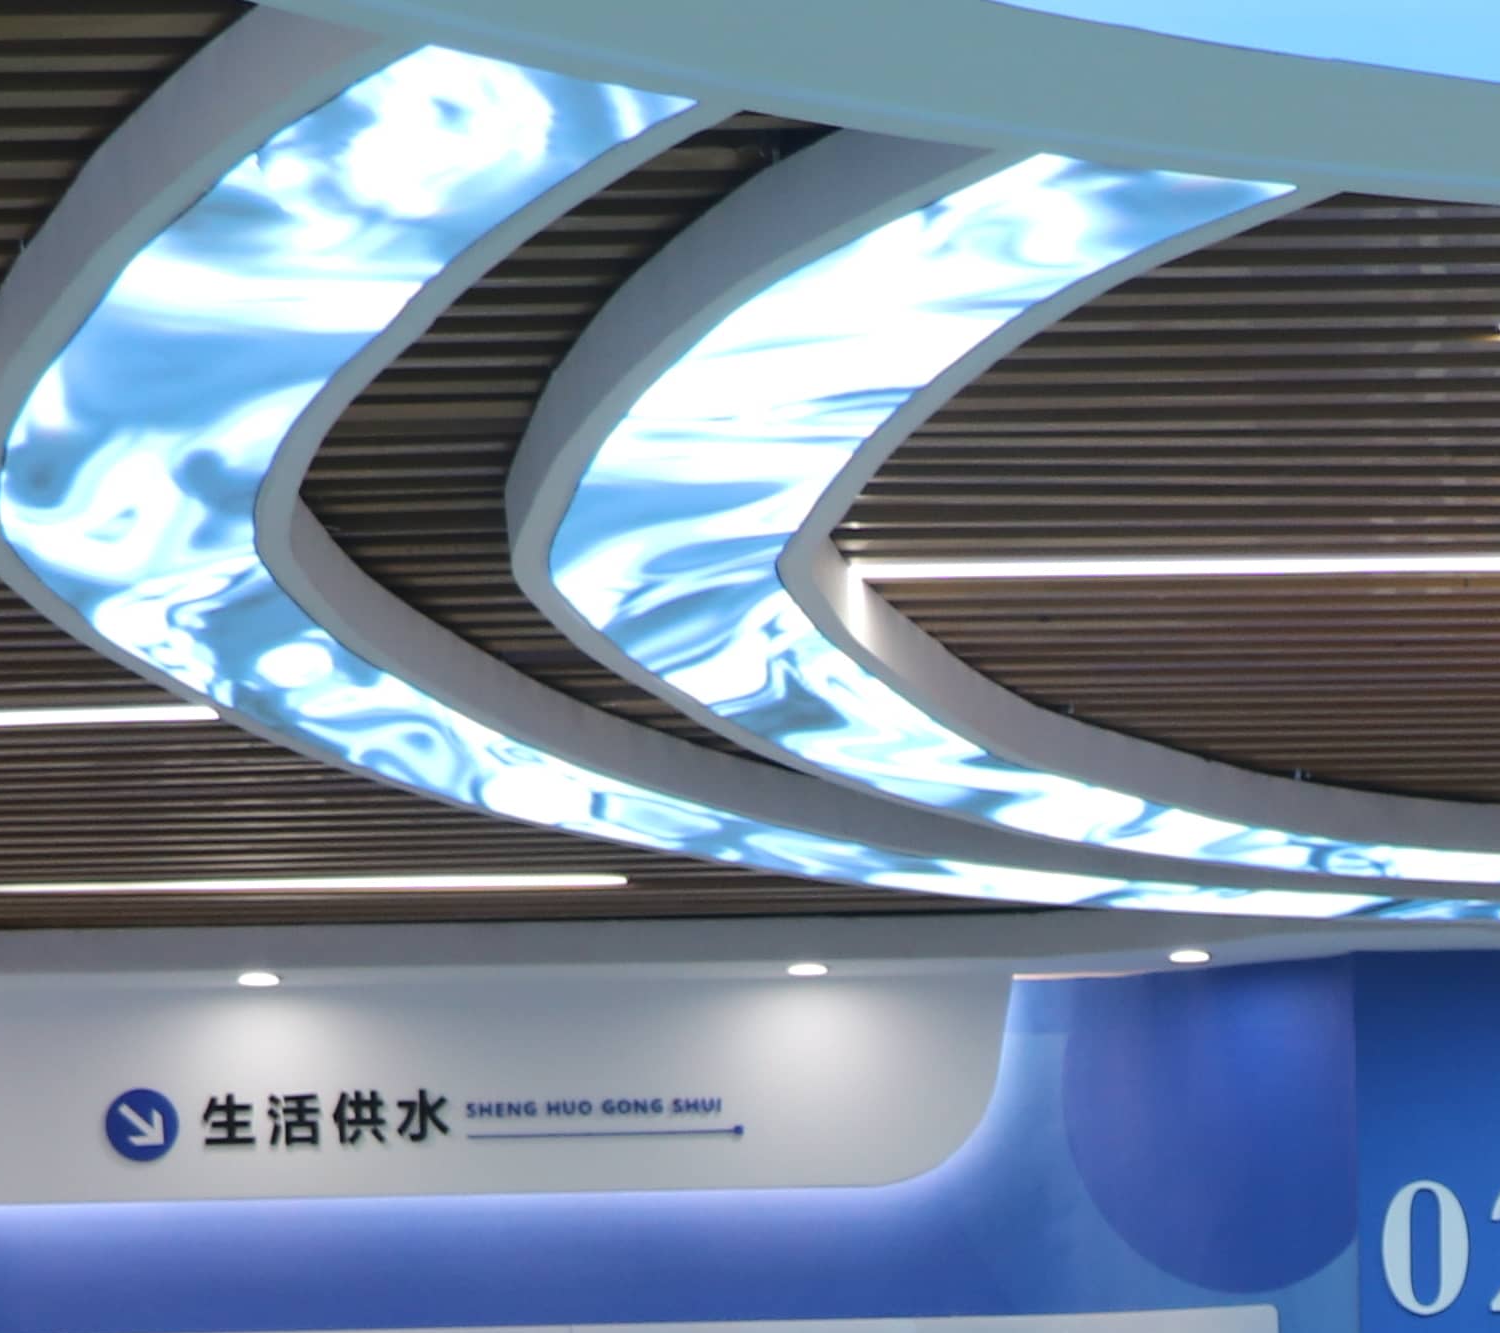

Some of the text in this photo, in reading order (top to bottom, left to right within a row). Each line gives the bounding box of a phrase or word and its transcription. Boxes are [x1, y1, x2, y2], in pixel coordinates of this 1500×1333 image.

[202, 1089, 451, 1149] 生活供水
[466, 1096, 723, 1119] SHENG HUO GONG SHUI
